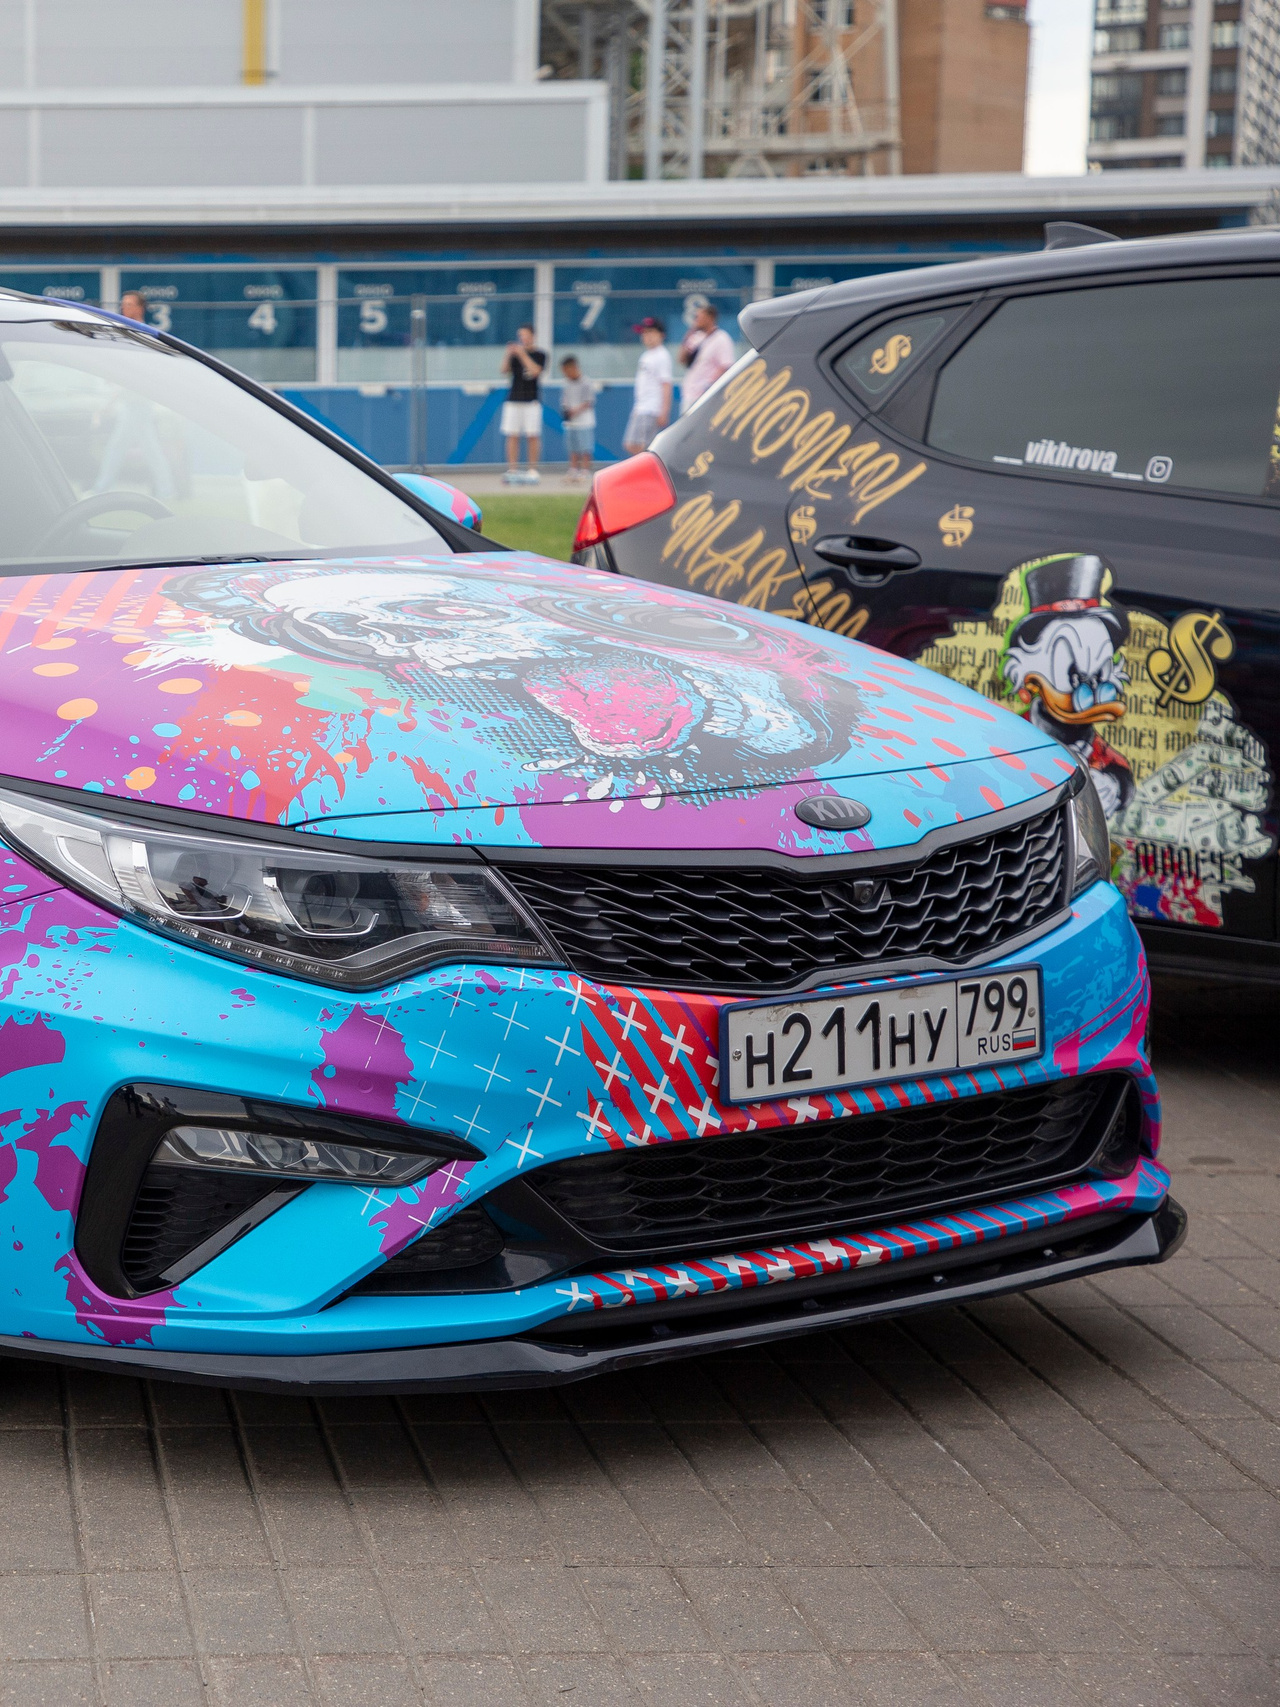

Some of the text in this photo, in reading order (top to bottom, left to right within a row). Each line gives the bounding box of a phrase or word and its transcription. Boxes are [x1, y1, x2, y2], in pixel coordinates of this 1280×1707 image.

[146, 303, 172, 332] 3
[248, 302, 277, 335] 4
[359, 300, 388, 334] 5
[461, 297, 490, 332] 6
[577, 296, 605, 330] 7
[959, 975, 1029, 1037] 799
[977, 1032, 1012, 1056] RUS
